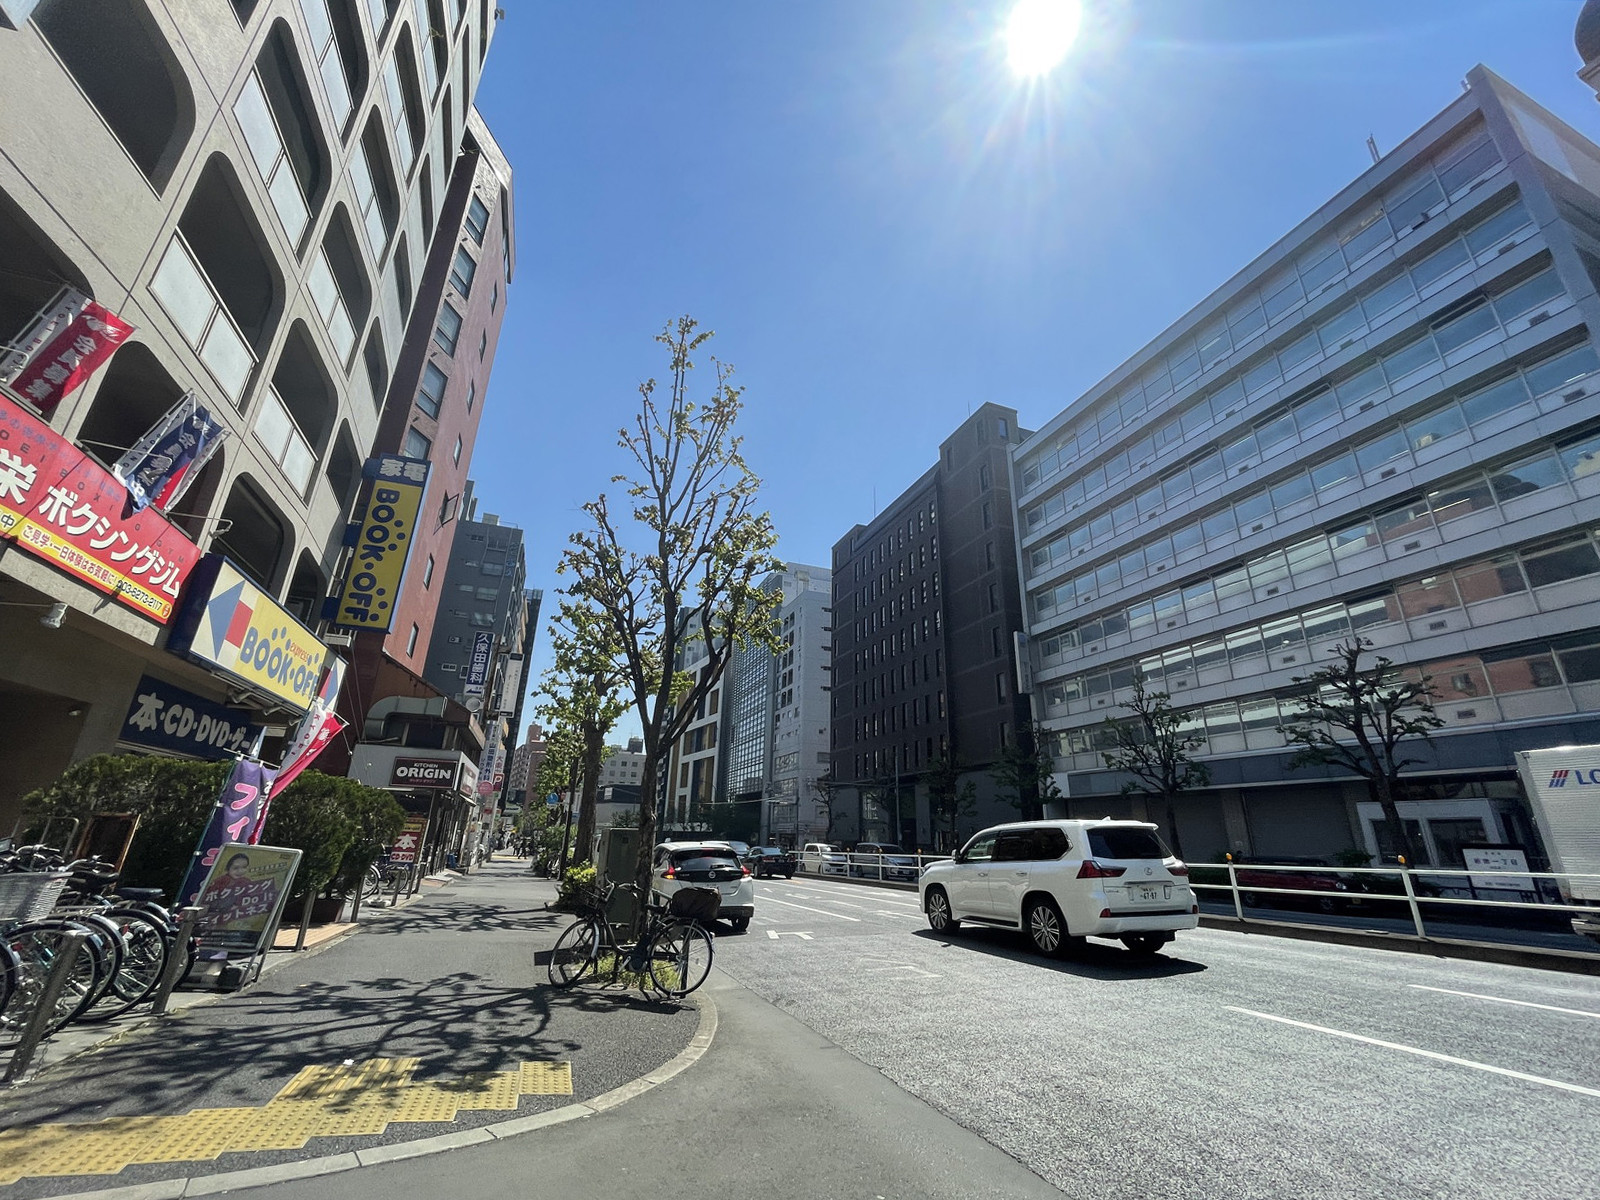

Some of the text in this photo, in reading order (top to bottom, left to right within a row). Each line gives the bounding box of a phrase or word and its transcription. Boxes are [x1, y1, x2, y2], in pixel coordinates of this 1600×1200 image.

[379, 458, 427, 482] 家電
[59, 468, 142, 532] BOXIG
[38, 485, 181, 600] ボクシングジム
[469, 633, 490, 684] 久保田歯科
[396, 766, 452, 780] ORIGIN
[394, 833, 418, 850] 本
[205, 879, 274, 903] ボクシング
[241, 896, 260, 907] Do
